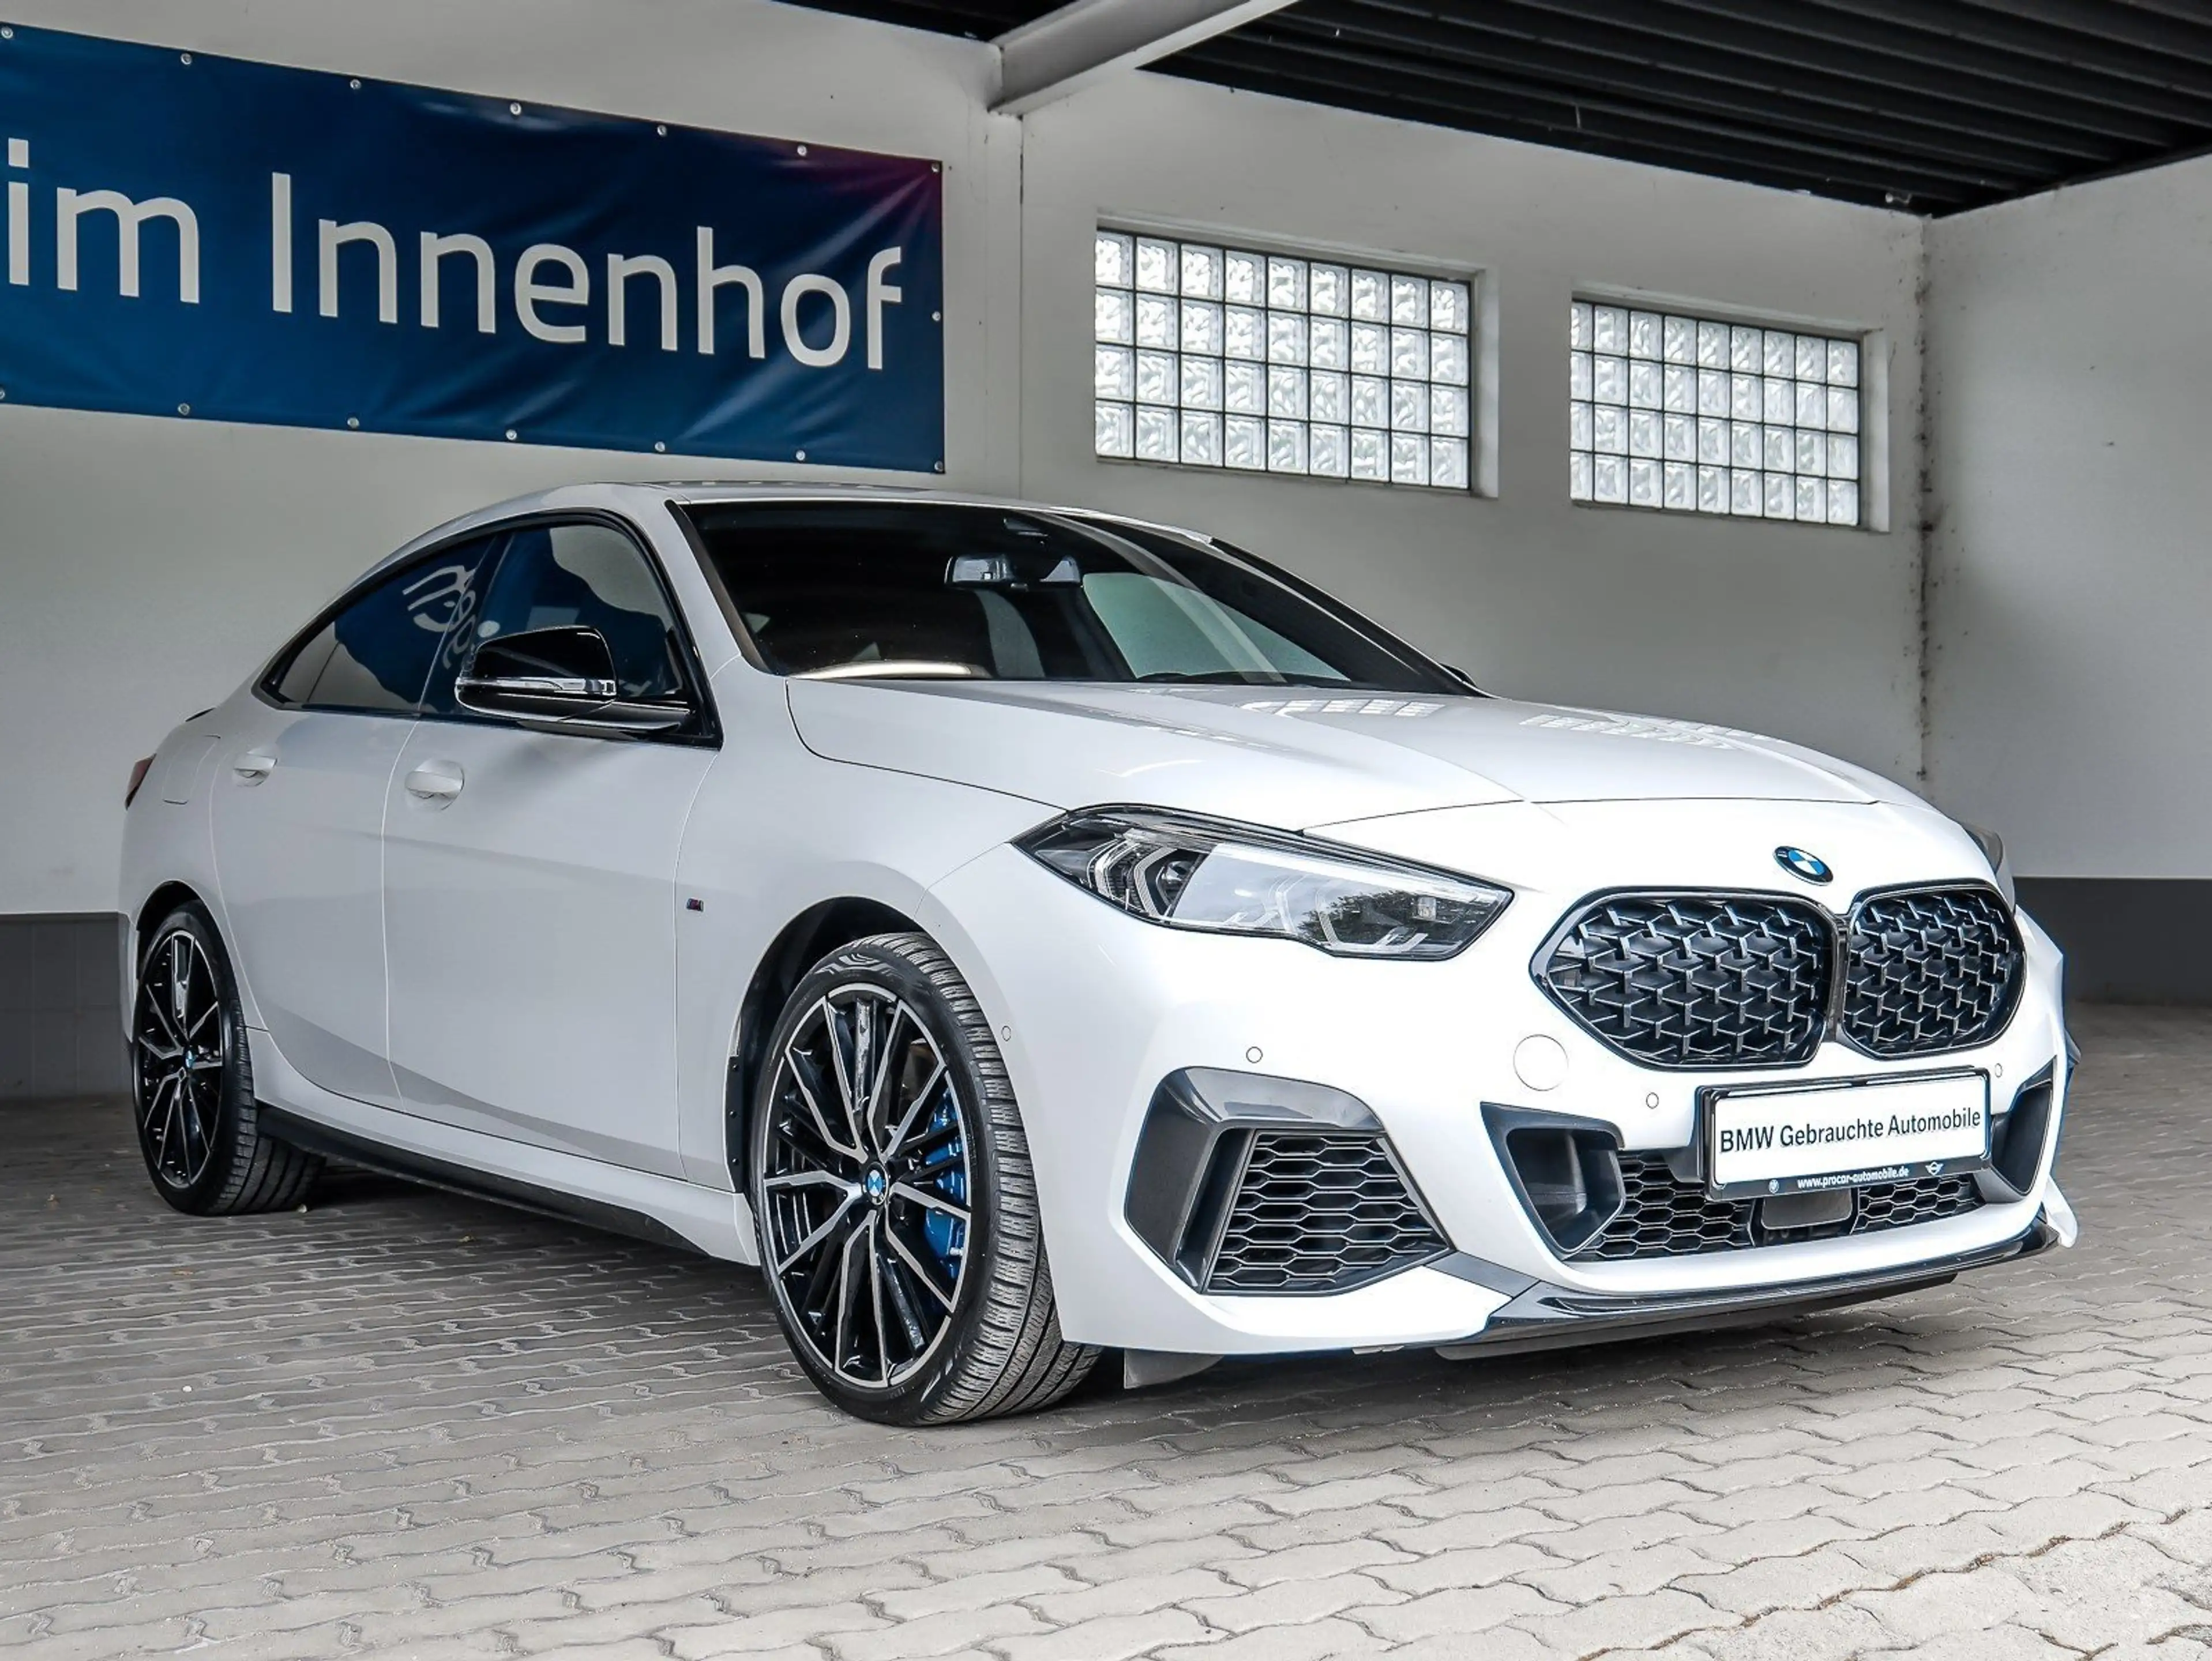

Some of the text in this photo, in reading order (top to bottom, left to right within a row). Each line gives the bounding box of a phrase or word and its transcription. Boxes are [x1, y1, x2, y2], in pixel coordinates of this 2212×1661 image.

[8, 138, 902, 370] im Innenhof
[1721, 1107, 1980, 1153] BMW Gebrauchte Automobile
[1797, 1166, 1910, 1188] www.procar-automobile.de
